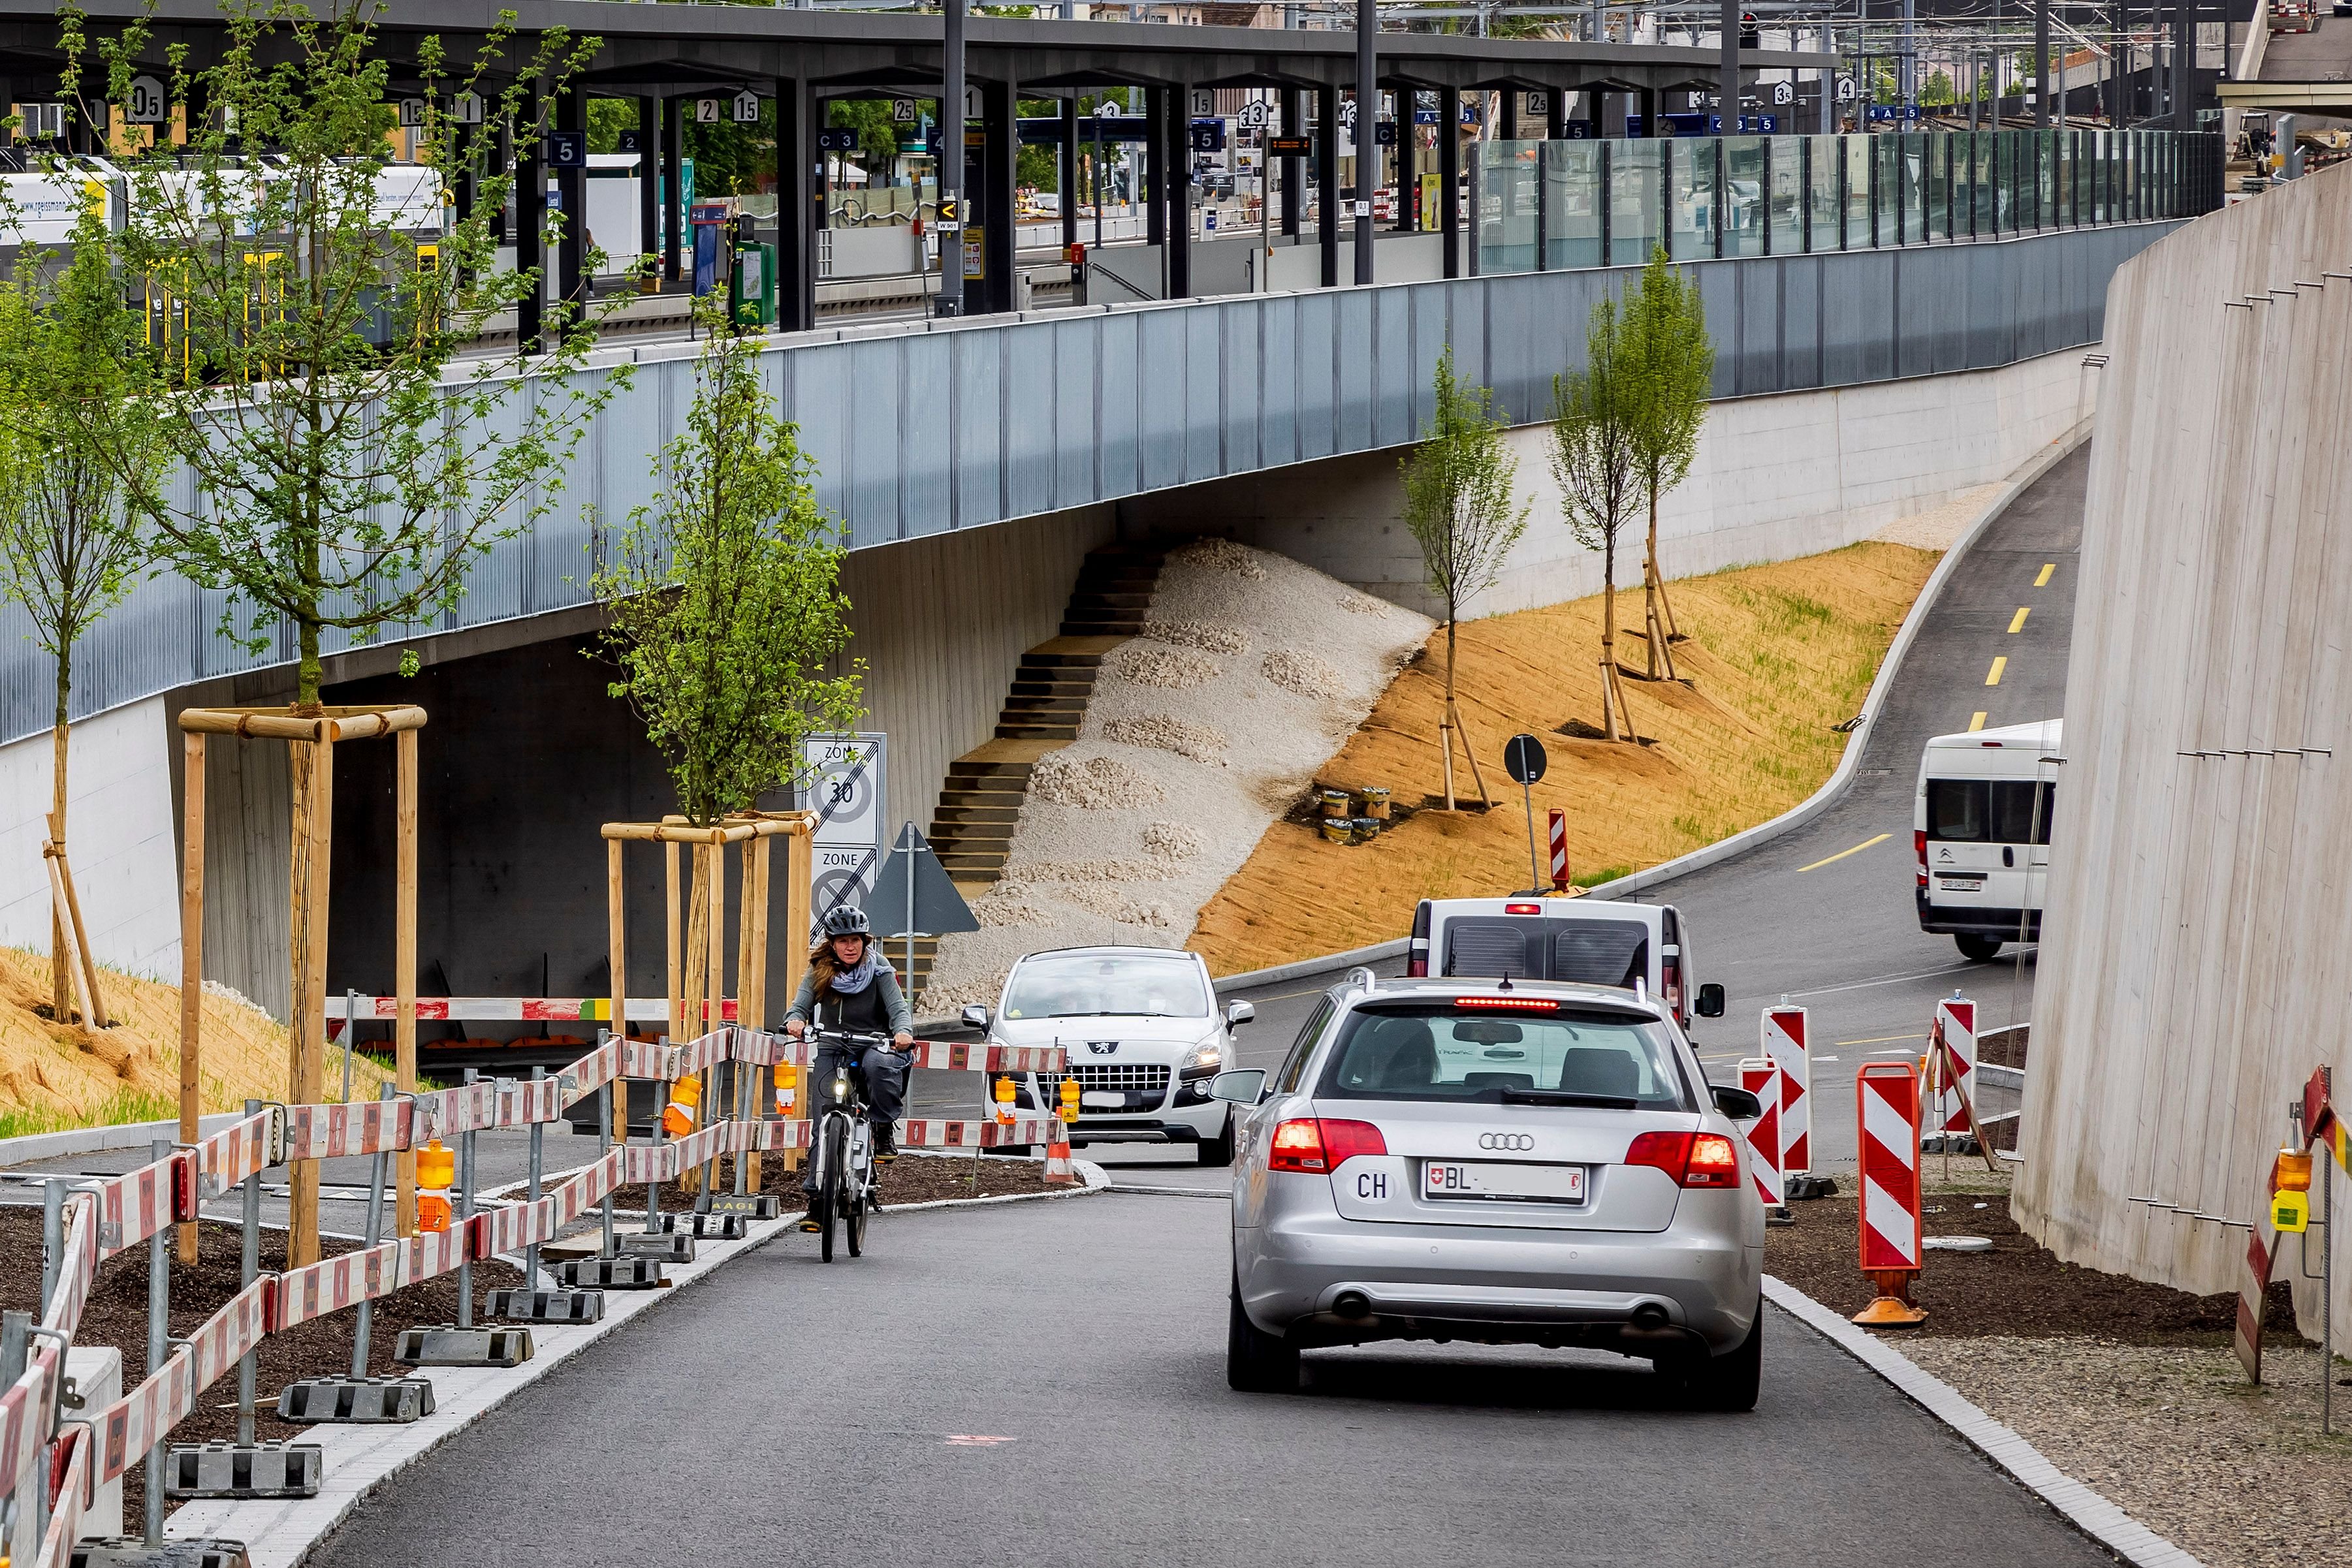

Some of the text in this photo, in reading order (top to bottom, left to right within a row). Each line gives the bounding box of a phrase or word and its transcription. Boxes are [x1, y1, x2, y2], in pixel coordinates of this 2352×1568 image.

[1777, 88, 1790, 102] 35
[1841, 82, 1851, 97] 4
[737, 97, 755, 119] 15
[1192, 91, 1208, 112] 15
[1531, 93, 1546, 111] 25
[703, 101, 712, 120] 2
[897, 101, 912, 119] 25
[1107, 105, 1115, 117] 3
[1253, 106, 1262, 123] 3
[1869, 109, 1875, 118] 4
[1884, 109, 1892, 118] A
[1909, 109, 1915, 118] 5
[1764, 120, 1772, 130] 5
[1379, 129, 1390, 140] C
[1574, 127, 1582, 138] 5
[626, 137, 634, 148] 2
[820, 135, 851, 146] C 3
[934, 136, 944, 149] 4
[1201, 133, 1212, 147] 5
[560, 142, 573, 161] 5
[831, 782, 853, 804] 30
[823, 853, 858, 866] ZONE
[1357, 1173, 1386, 1199] CH
